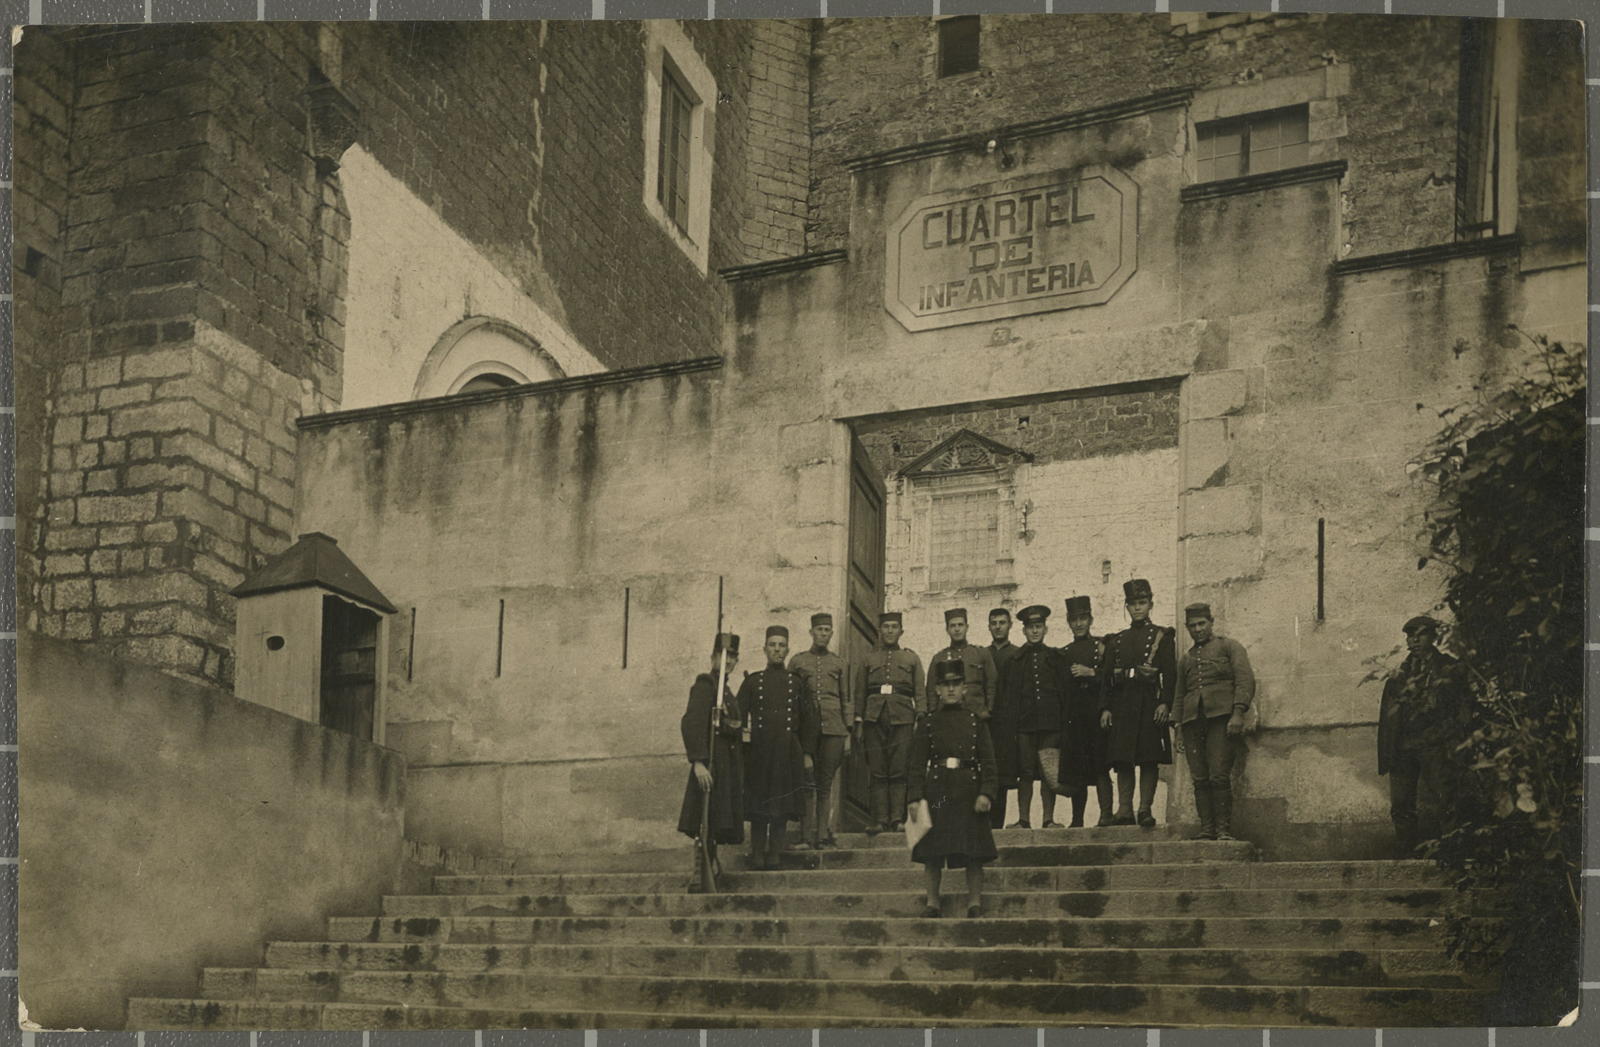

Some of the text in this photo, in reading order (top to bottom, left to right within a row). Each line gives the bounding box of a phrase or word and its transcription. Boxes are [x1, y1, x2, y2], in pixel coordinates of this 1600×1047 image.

[922, 186, 1095, 250] CUARTEL
[968, 235, 1034, 274] DE
[919, 259, 1095, 311] INFANTERIA
